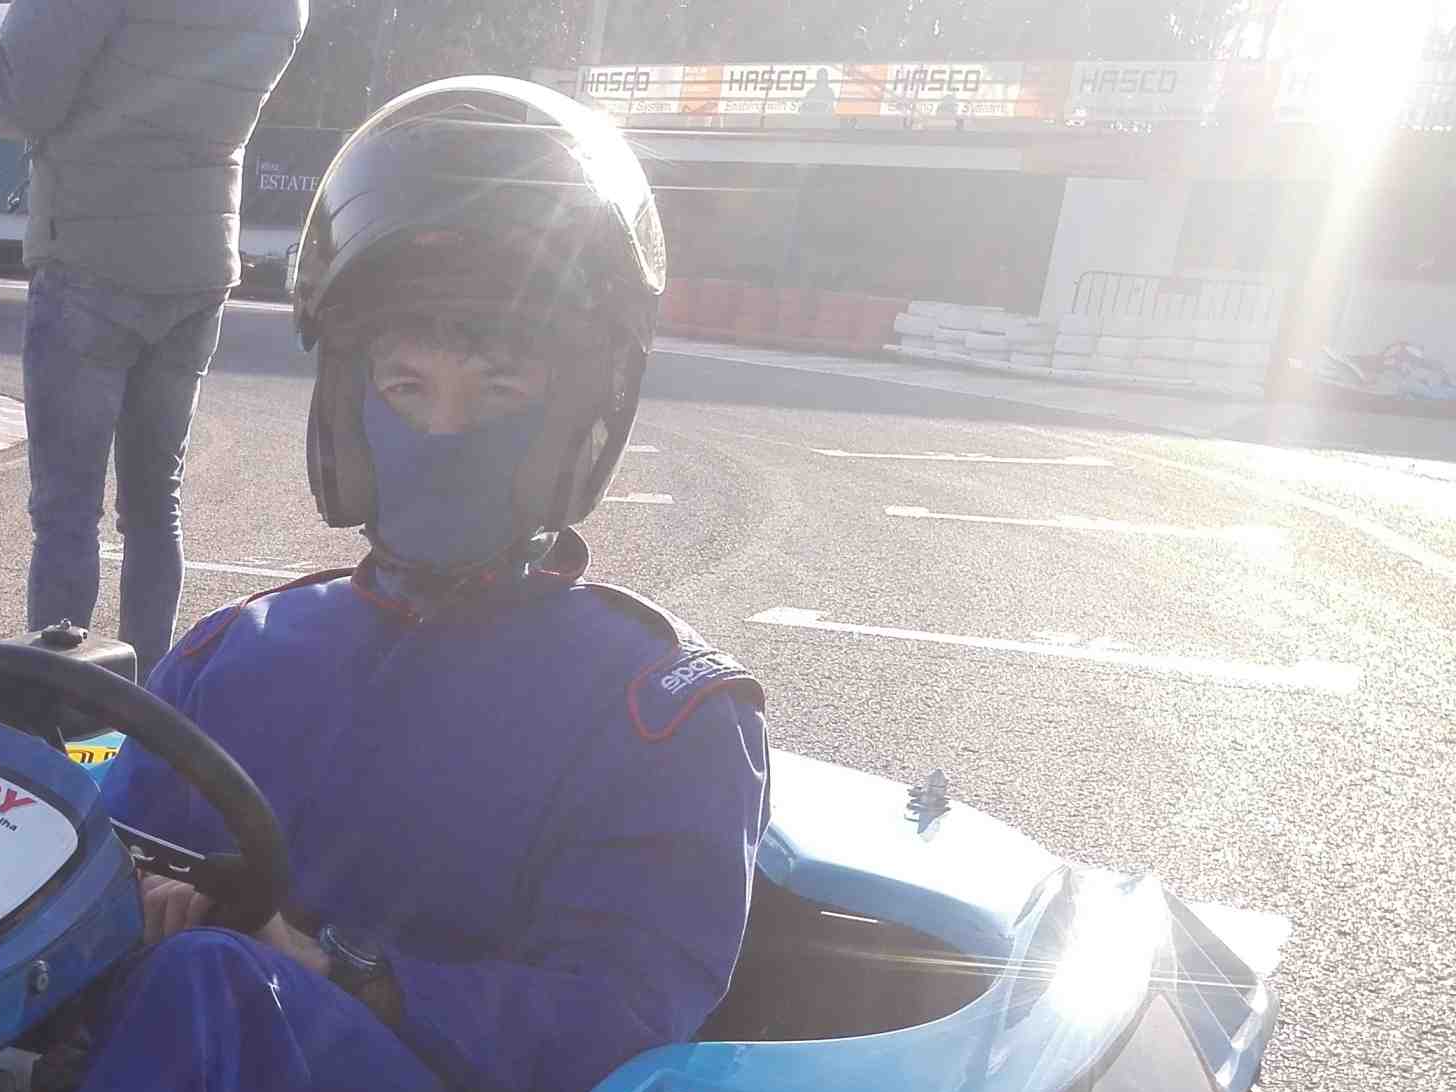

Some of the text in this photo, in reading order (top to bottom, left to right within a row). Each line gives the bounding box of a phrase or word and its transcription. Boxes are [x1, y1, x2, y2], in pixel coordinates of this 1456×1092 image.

[728, 69, 807, 92] HASCO
[894, 69, 981, 92] HASCO
[1078, 69, 1177, 94] HASCO
[260, 173, 320, 192] ESTATE
